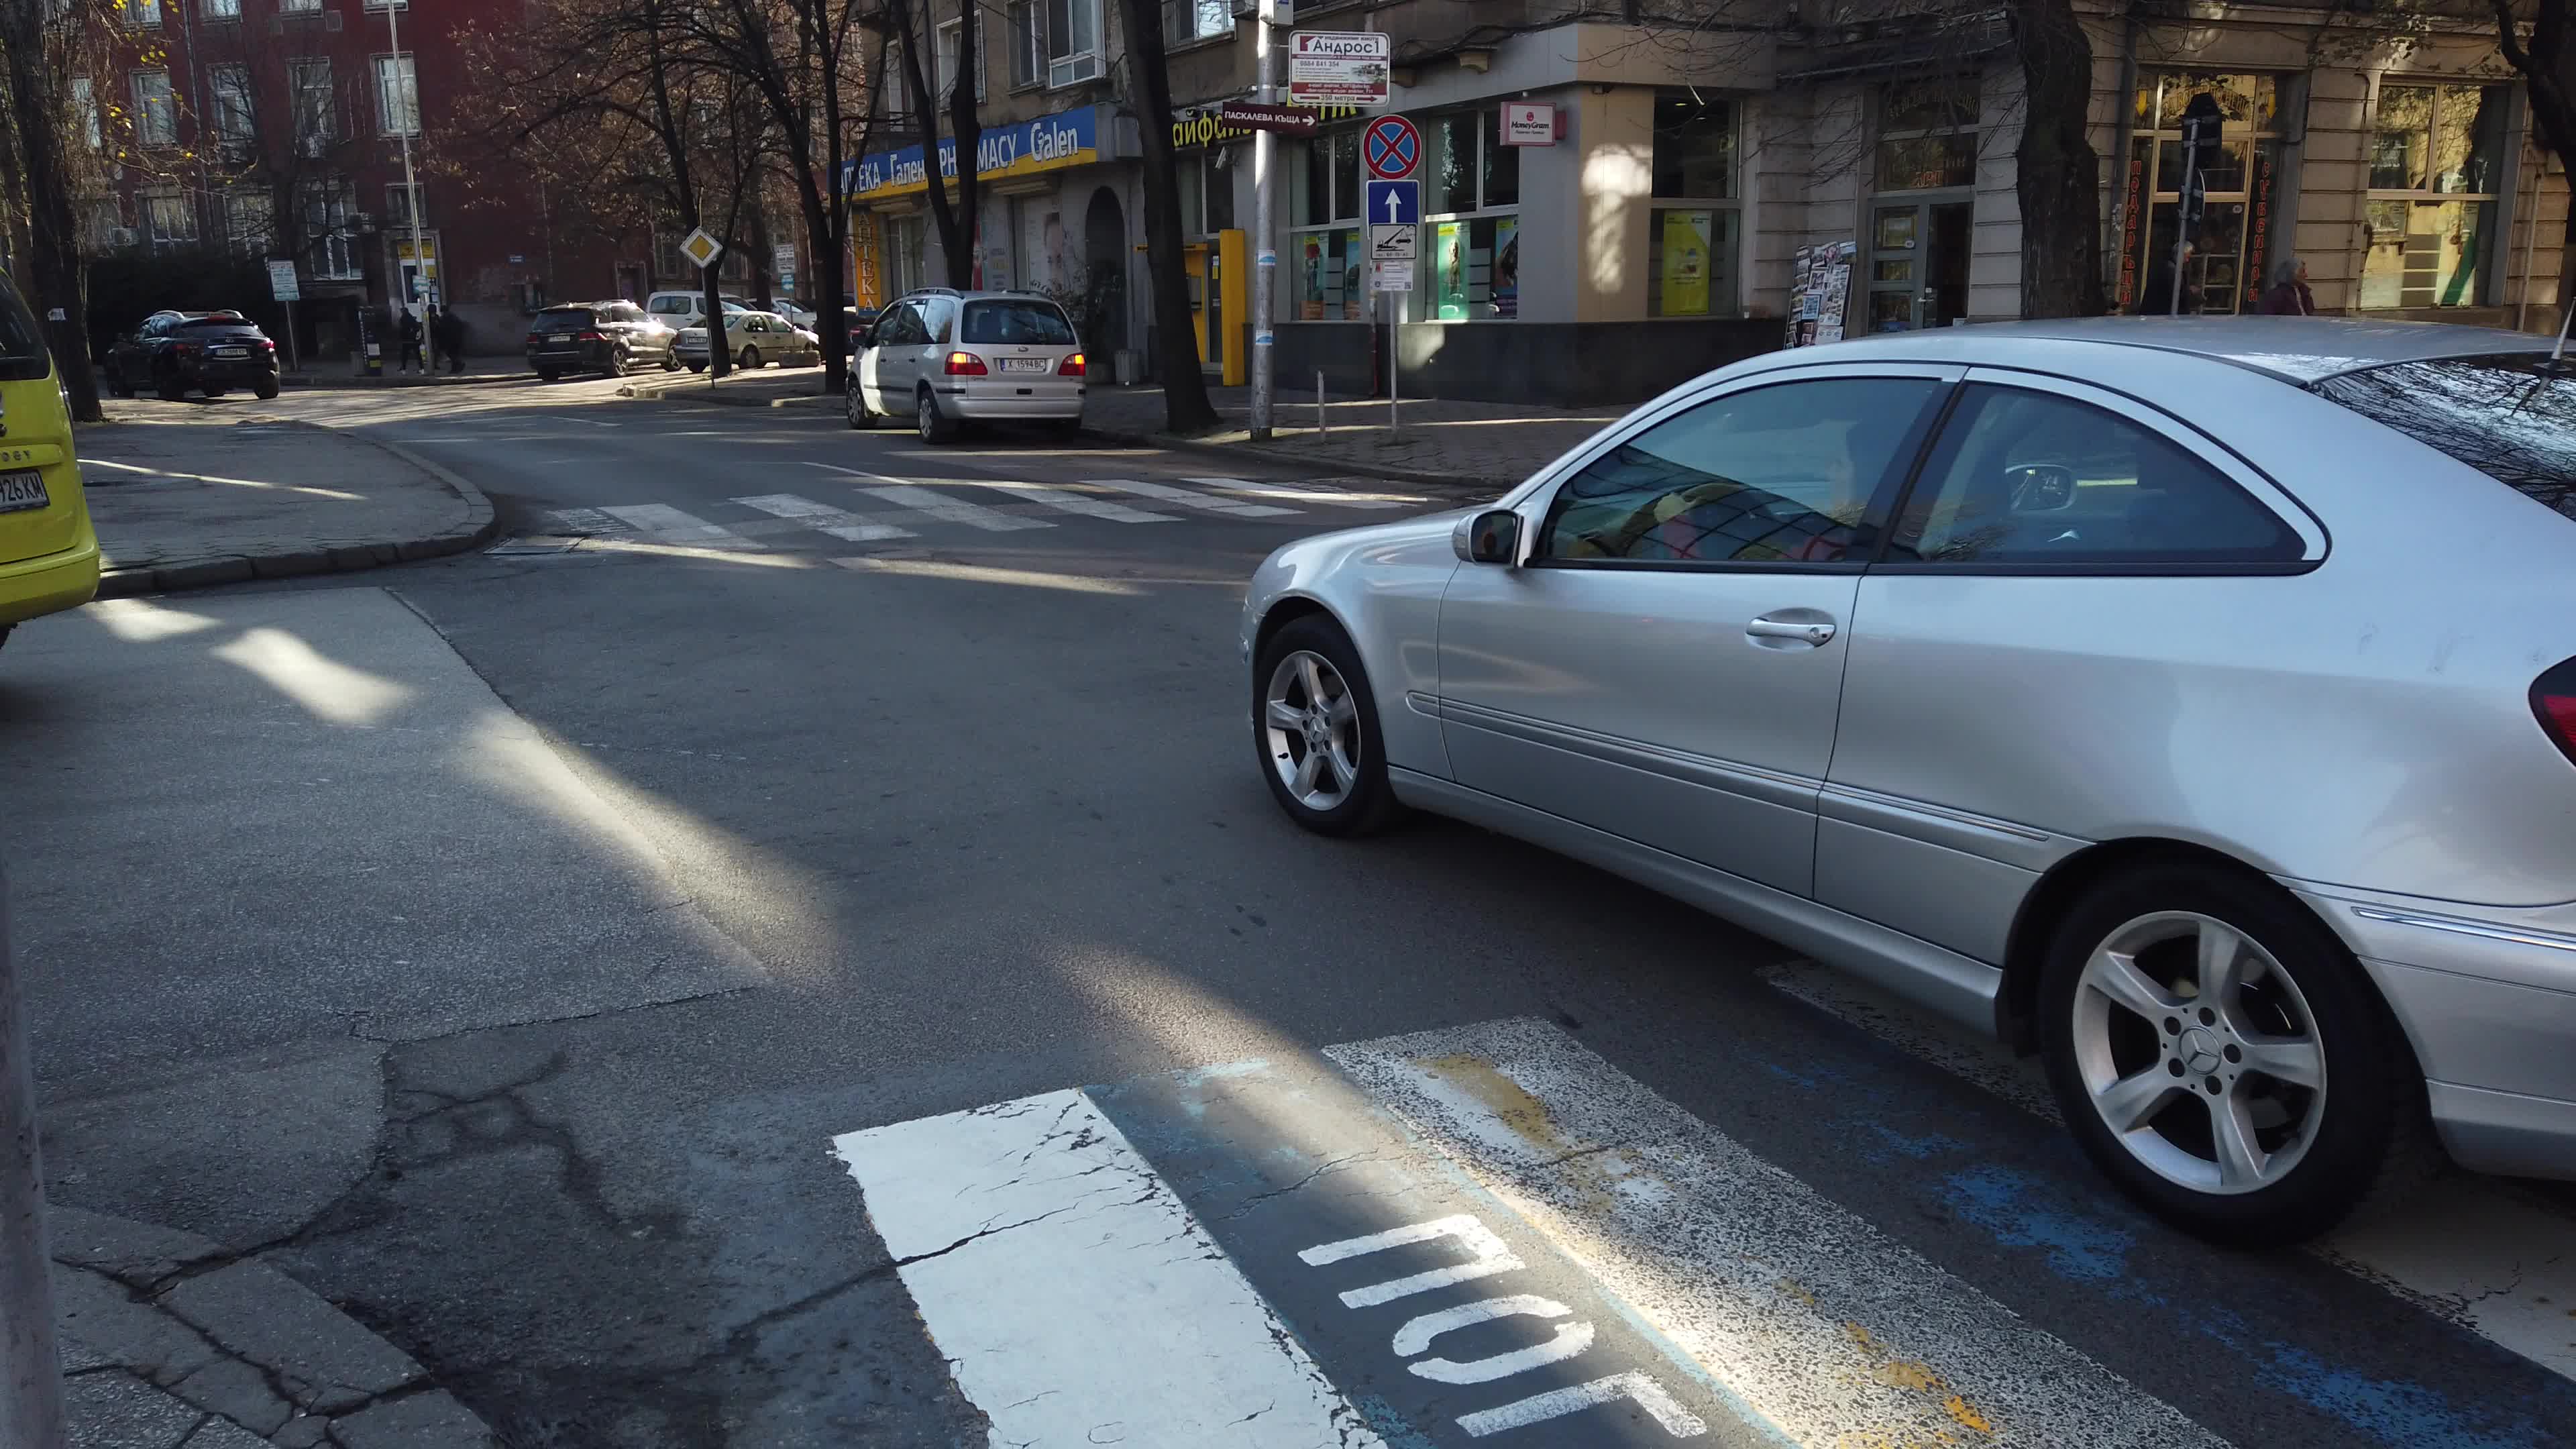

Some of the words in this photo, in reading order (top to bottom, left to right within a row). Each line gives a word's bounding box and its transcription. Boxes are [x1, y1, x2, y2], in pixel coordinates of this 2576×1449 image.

[1224, 111, 1273, 122] ПАСКАЛЕВА
[1275, 115, 1300, 124] КЪЩА
[1511, 121, 1550, 129] MoneyGram
[939, 133, 1017, 177] PHMACY
[1030, 121, 1079, 162] Galen
